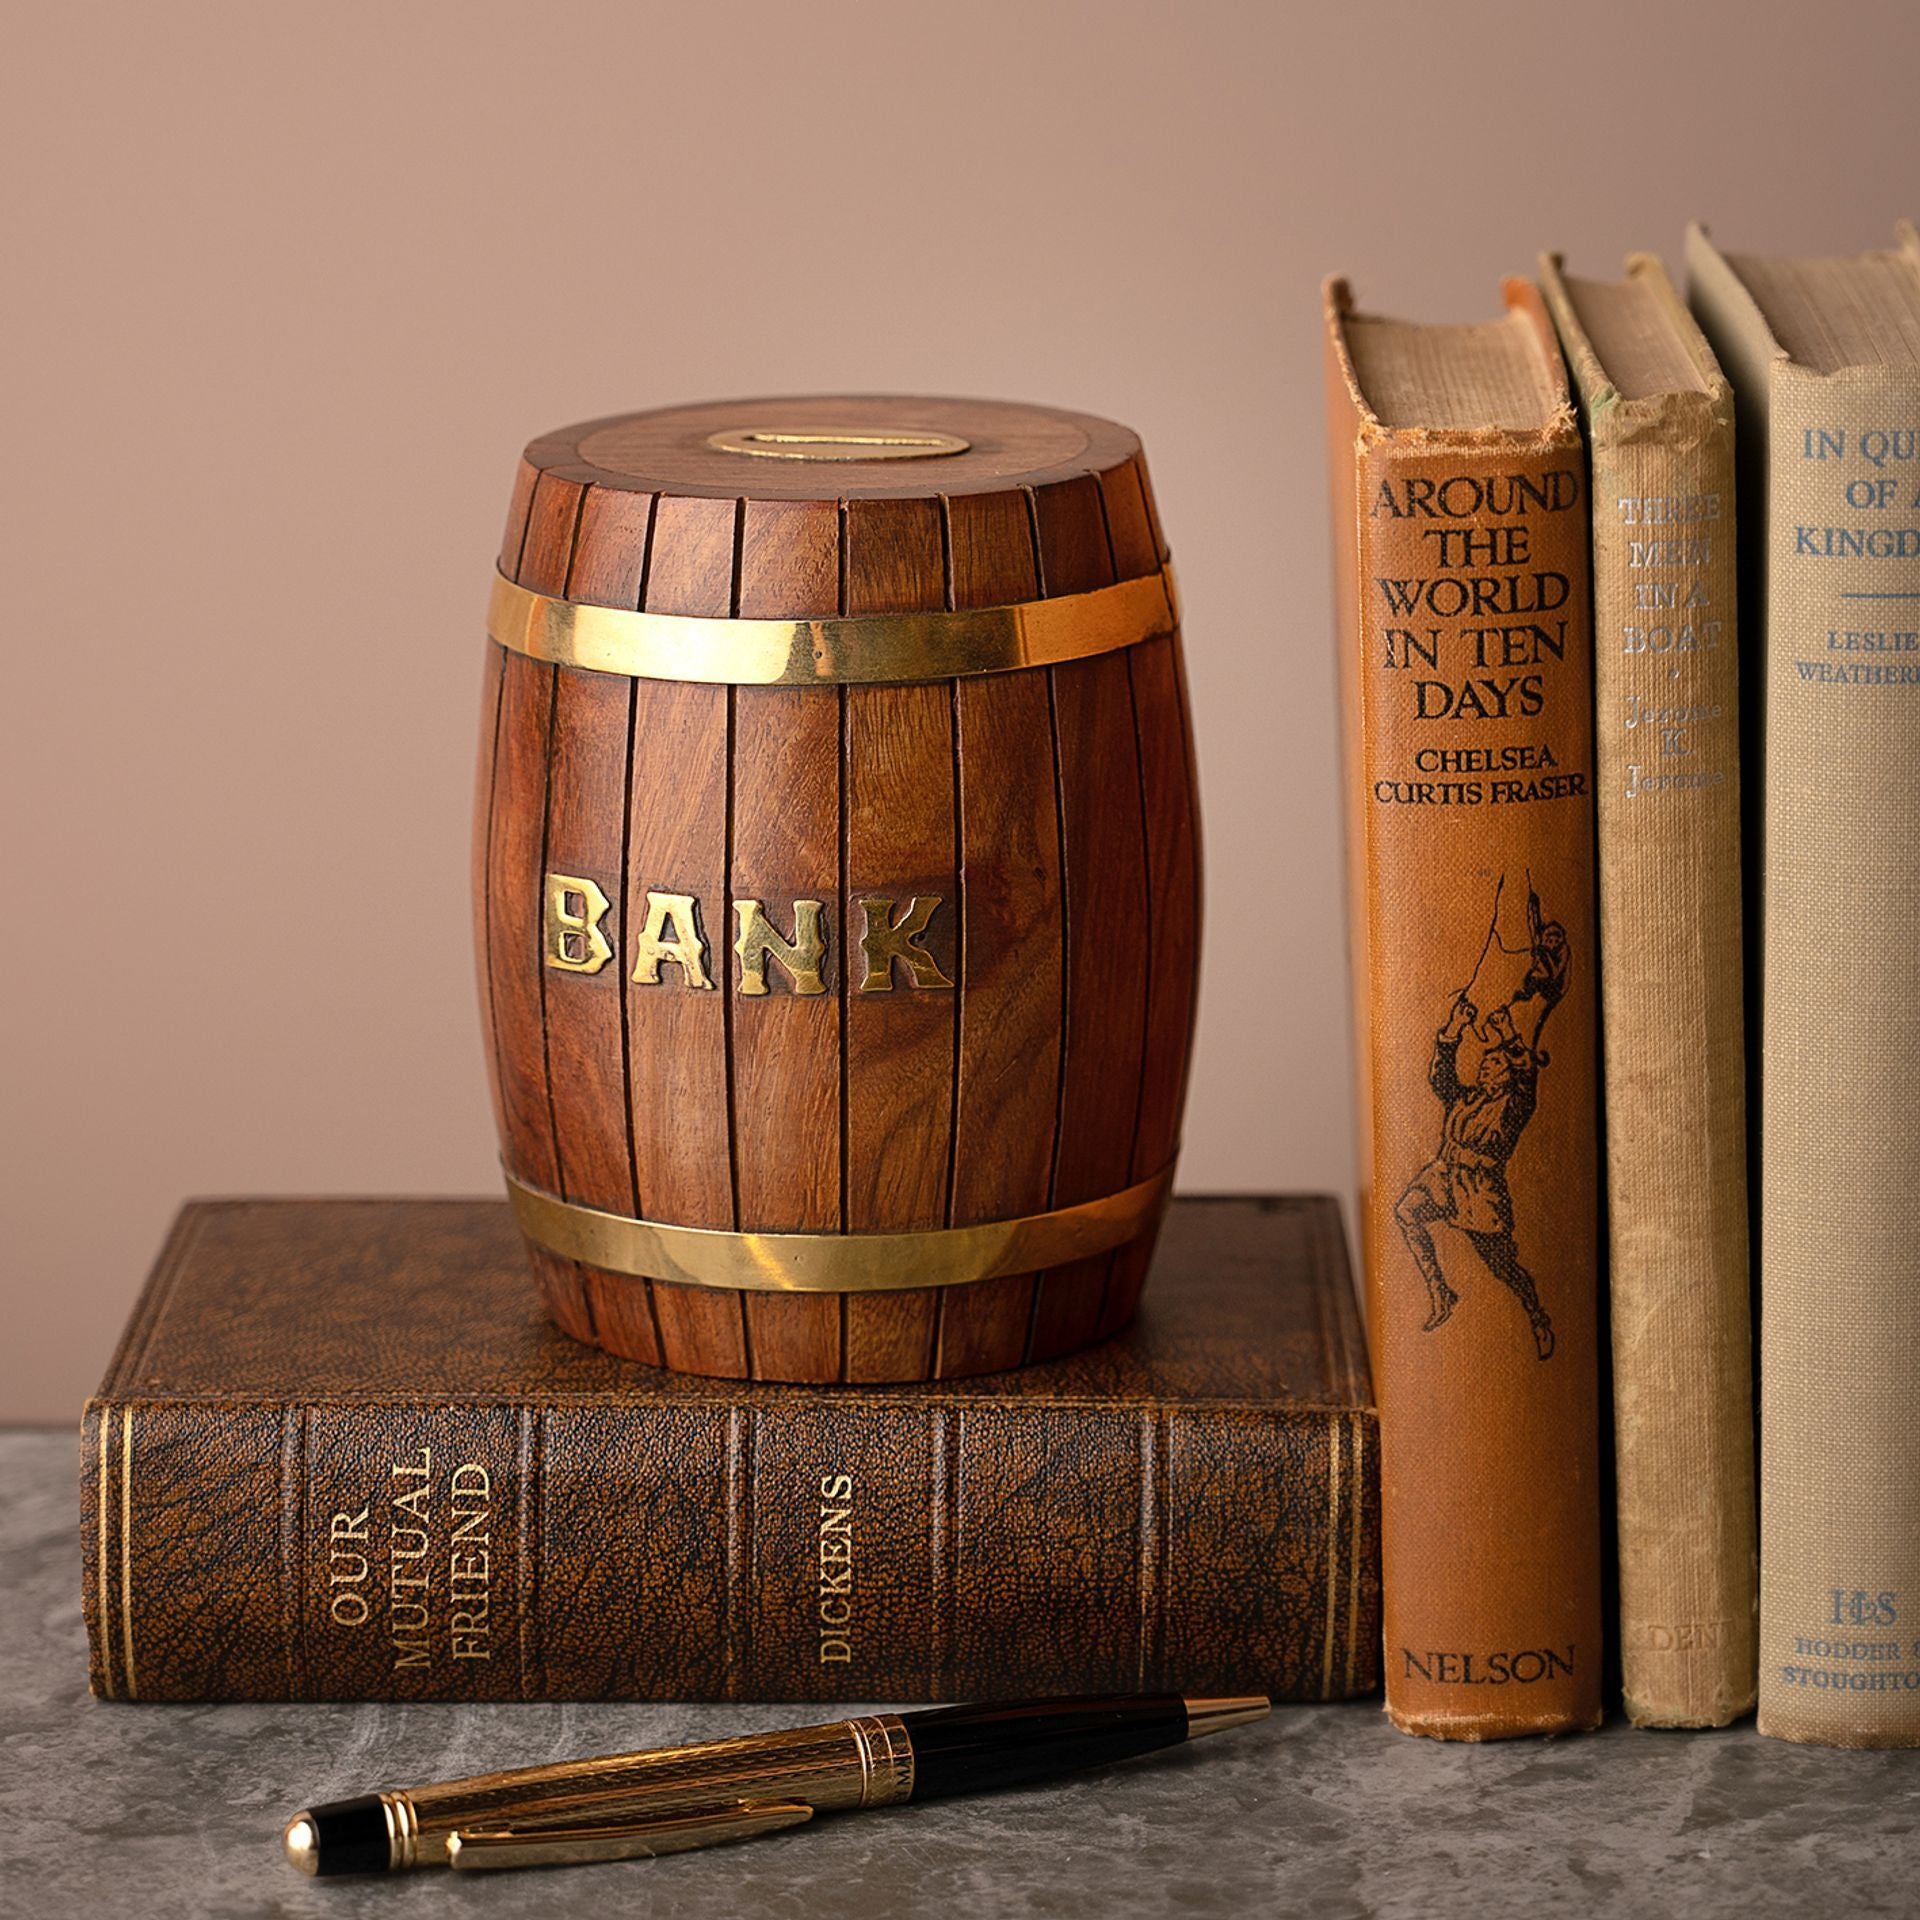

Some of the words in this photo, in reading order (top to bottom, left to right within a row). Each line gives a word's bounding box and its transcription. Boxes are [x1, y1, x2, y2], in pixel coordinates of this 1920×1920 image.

[1803, 428, 1845, 460] IN
[1860, 429, 1920, 468] QU
[1371, 470, 1580, 519] AROUND
[1618, 494, 1721, 524] THREE
[1846, 479, 1898, 509] OF
[1422, 526, 1532, 568] THE
[1629, 539, 1713, 568] MEN
[1375, 572, 1571, 618] WORLD
[1635, 582, 1679, 610] IN
[1685, 580, 1711, 609] A
[1383, 628, 1442, 671] IN
[1459, 620, 1569, 668] TEN
[1623, 621, 1722, 654] BOAT
[1827, 631, 1920, 651] LESLIE
[1411, 675, 1545, 721] DAYS
[1624, 695, 1722, 729] Jerome
[1415, 745, 1558, 773] CHELSEA
[1374, 780, 1483, 805] CURTIS
[1491, 772, 1589, 804] FRASER
[1624, 763, 1725, 799] Jerome
[544, 873, 955, 996] BANK
[330, 1505, 369, 1626] OUR
[392, 1446, 431, 1669] MUTUAL
[450, 1463, 490, 1661] FRIEND
[820, 1475, 852, 1663] DICKENS
[1402, 1644, 1576, 1685] NELSON
[1795, 1638, 1901, 1661] HODDER
